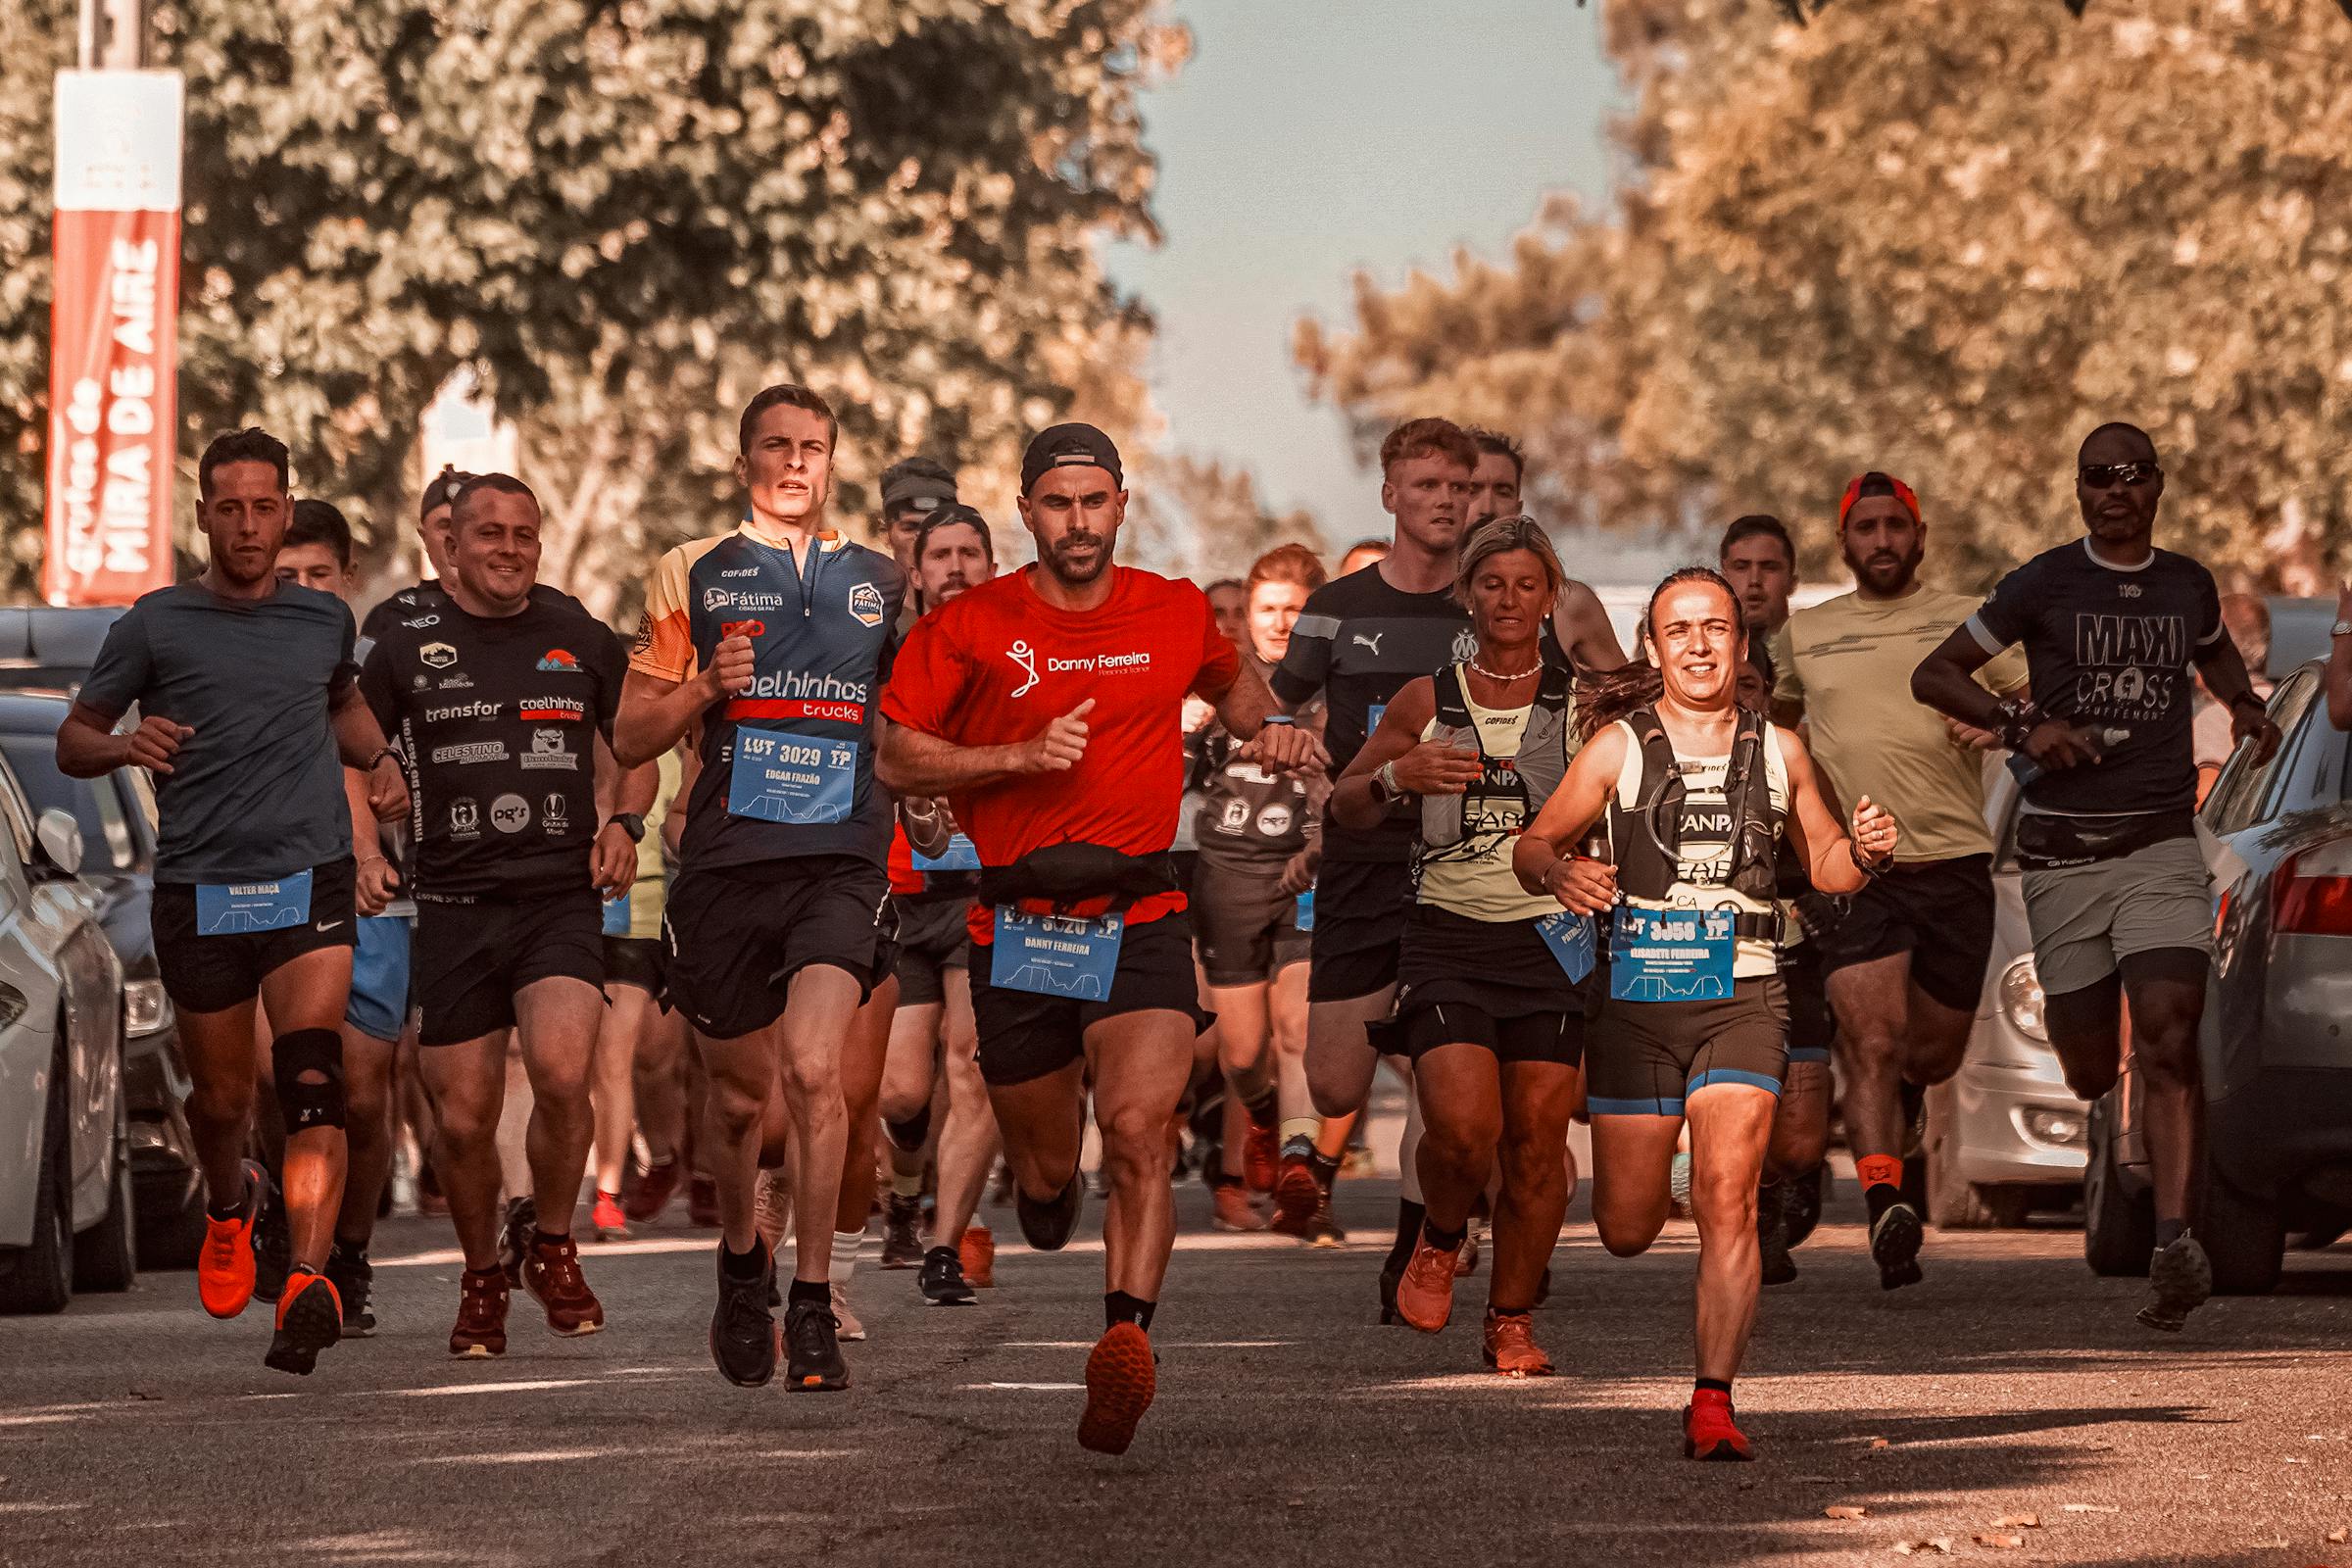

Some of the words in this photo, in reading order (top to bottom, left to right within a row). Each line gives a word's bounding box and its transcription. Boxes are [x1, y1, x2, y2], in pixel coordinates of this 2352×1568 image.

[111, 238, 158, 354] AIRE
[109, 365, 155, 434] DE
[103, 444, 151, 572] MIRA
[721, 566, 760, 578] COFIDES
[729, 591, 783, 607] Fátima
[401, 614, 440, 629] NEO
[2077, 613, 2186, 668] MAXI
[1048, 658, 1096, 672] Danny
[1098, 651, 1150, 668] Ferreira
[729, 670, 867, 703] oelhinhos
[425, 700, 503, 722] transfor
[519, 696, 585, 711] coelhinhos
[803, 704, 859, 720] trucks
[1485, 715, 1519, 725] COFIDES
[433, 743, 503, 761] CELESTINO
[779, 745, 821, 766] 3029
[765, 769, 791, 781] EDGAR
[228, 885, 256, 896] VALTER
[1025, 936, 1054, 951] DANNY
[1054, 940, 1091, 956] FERREIRA
